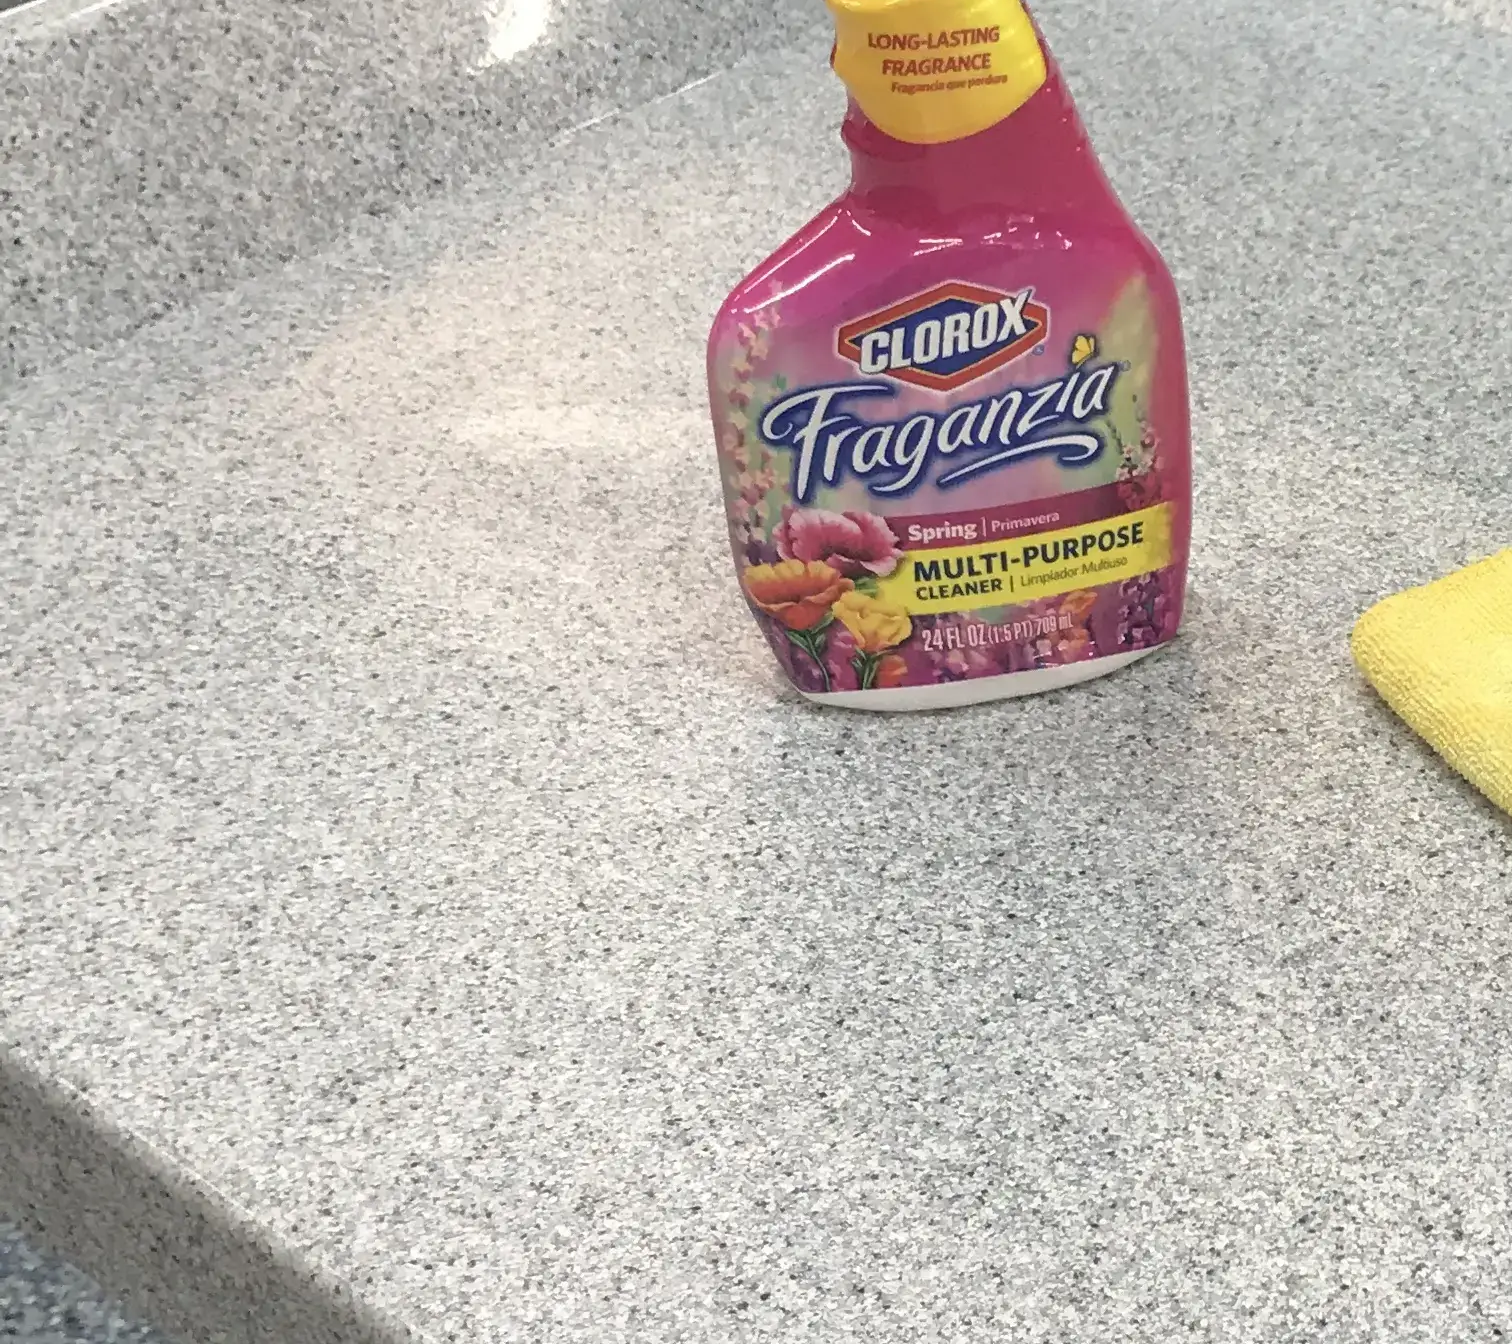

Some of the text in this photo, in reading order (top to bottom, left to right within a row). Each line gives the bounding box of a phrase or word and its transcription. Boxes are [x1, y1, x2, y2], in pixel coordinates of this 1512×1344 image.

[868, 24, 1000, 50] LONG-LASTING
[882, 52, 991, 77] FRAGRANCE
[891, 79, 945, 96] Fragancia
[946, 81, 967, 93] que
[858, 287, 1033, 375] CLOROX
[762, 361, 1117, 500] Fraganzia
[908, 512, 1060, 543] Spring Primavera
[913, 521, 1145, 583] MULTI-PURPOSE
[916, 555, 1128, 601] CLEANER Limpiador Multiuso
[921, 629, 943, 652] 24
[946, 626, 964, 649] FL
[968, 623, 986, 647] OZ
[1036, 615, 1057, 636] 709
[1058, 611, 1074, 631] mL
